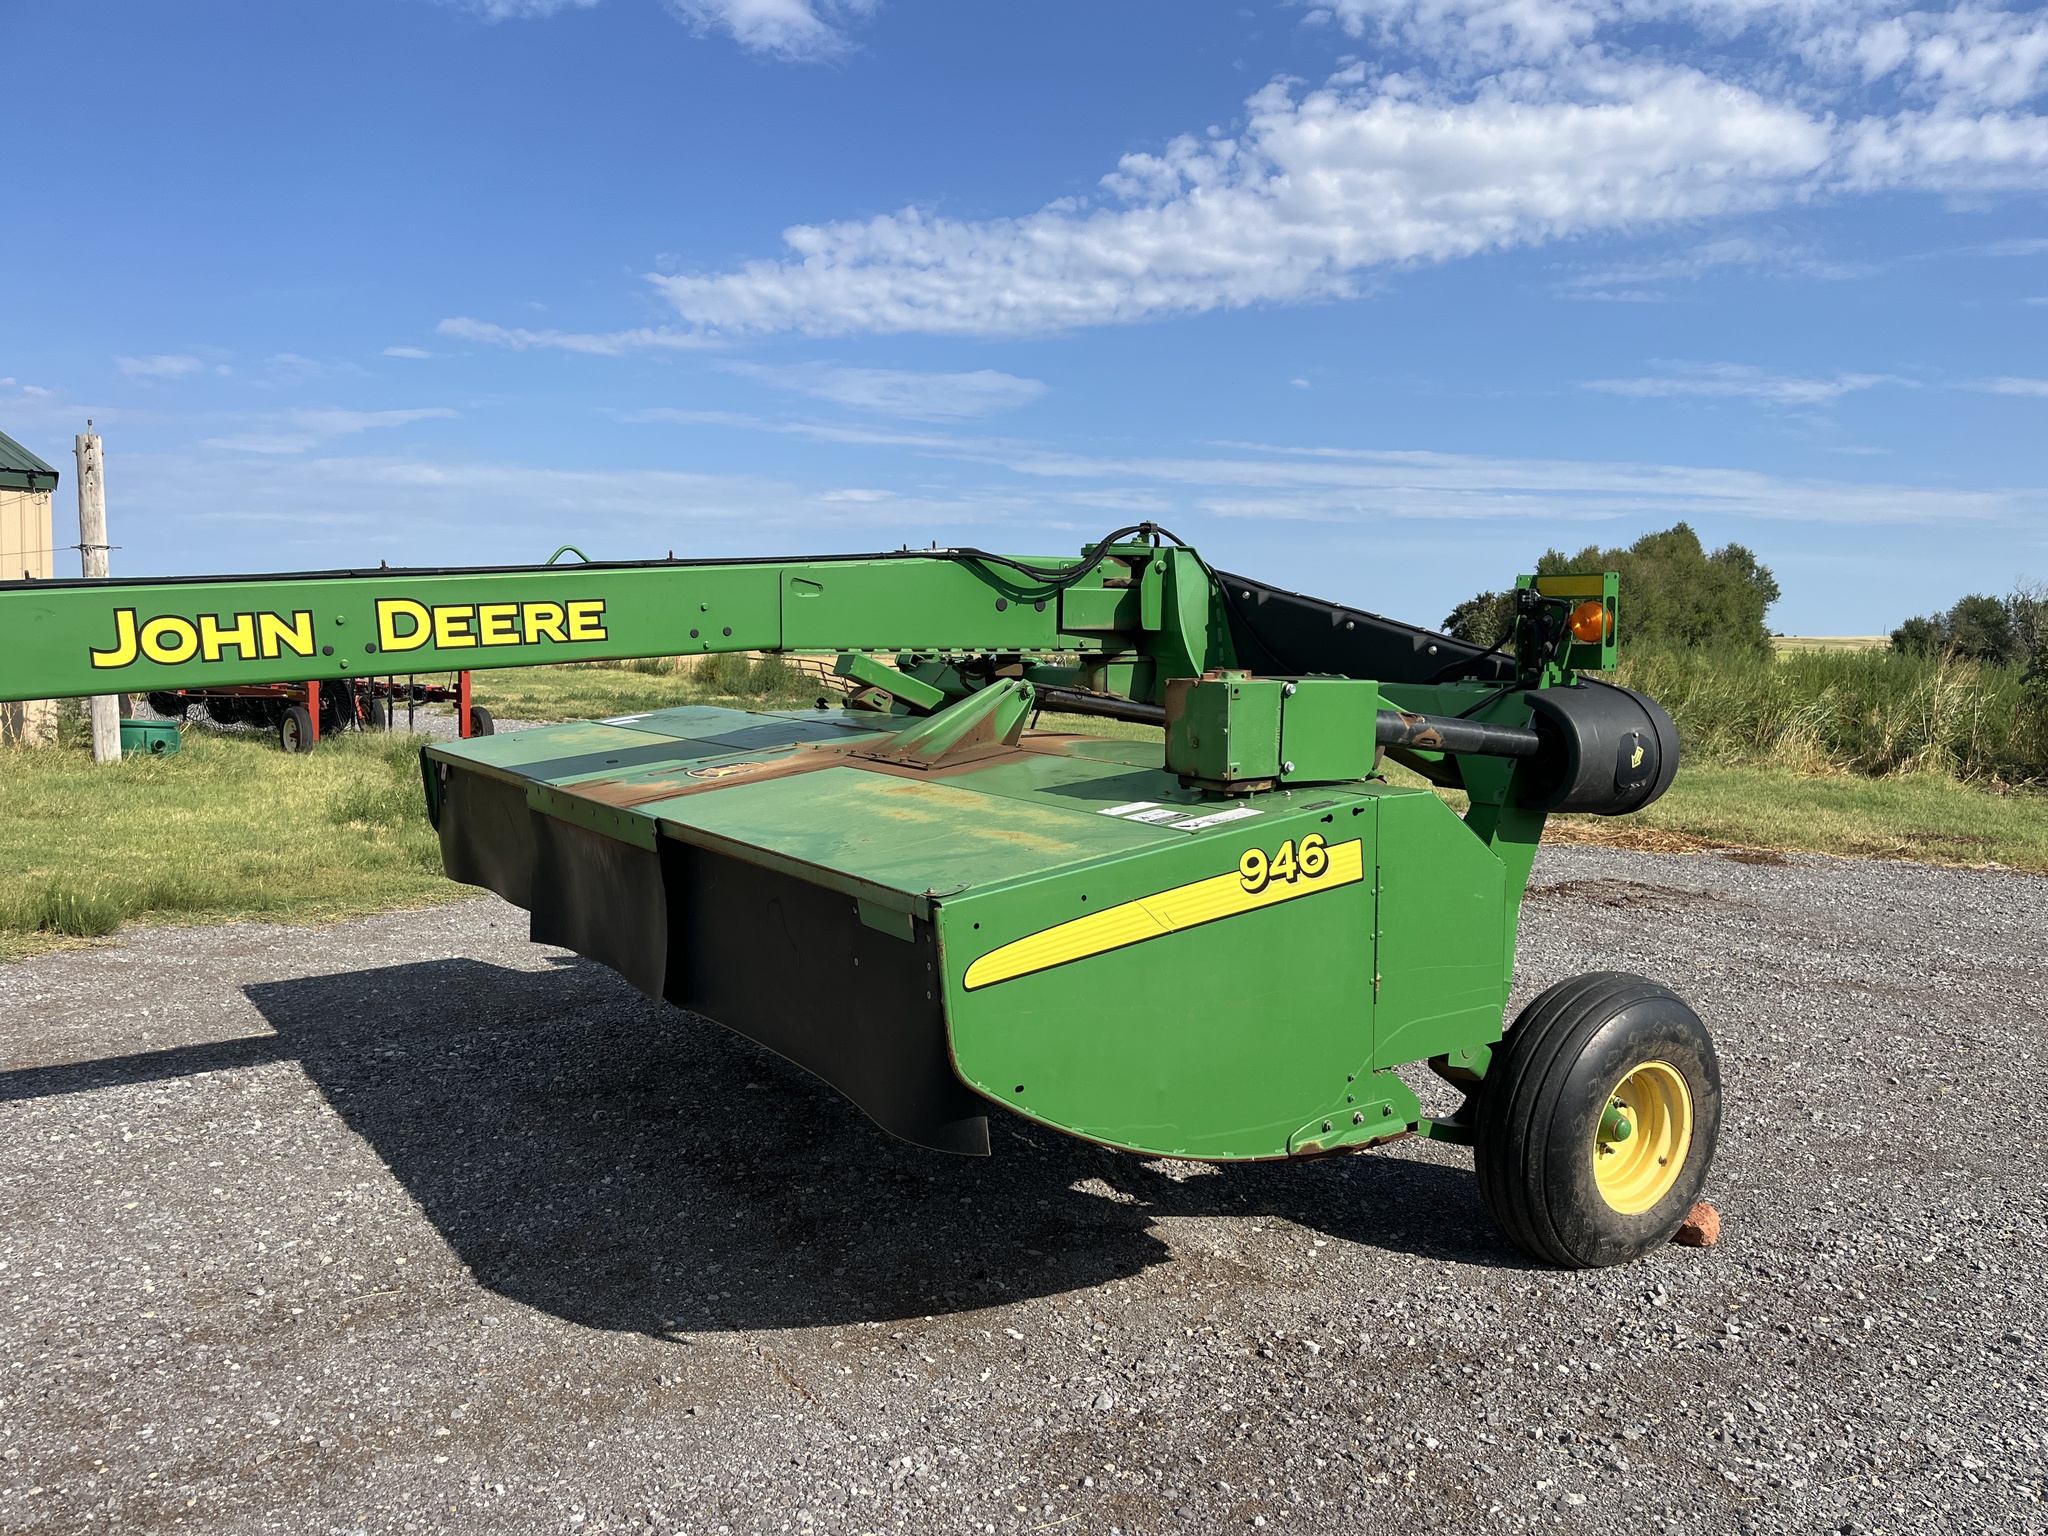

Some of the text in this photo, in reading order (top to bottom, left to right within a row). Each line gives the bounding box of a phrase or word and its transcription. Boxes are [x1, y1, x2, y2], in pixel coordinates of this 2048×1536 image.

[91, 598, 607, 668] JOHN DEERE
[1239, 833, 1329, 893] 946
